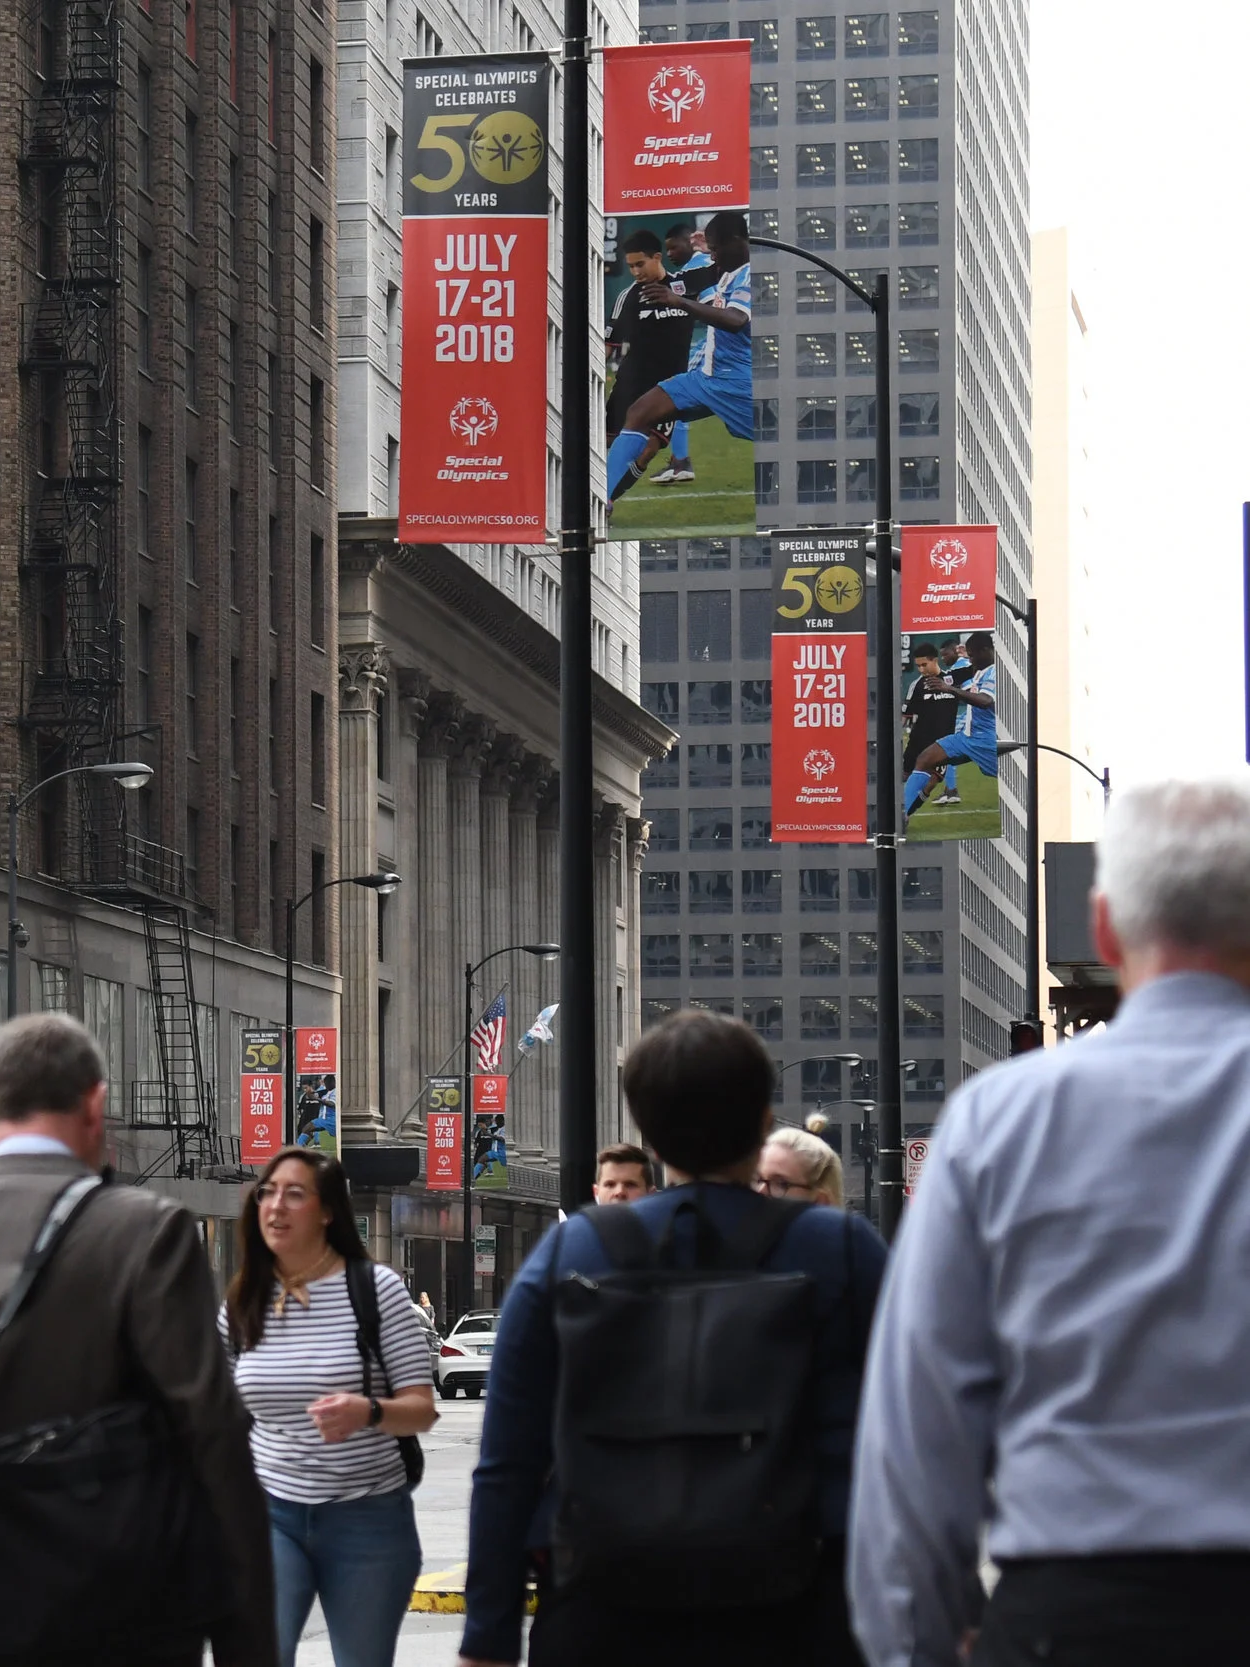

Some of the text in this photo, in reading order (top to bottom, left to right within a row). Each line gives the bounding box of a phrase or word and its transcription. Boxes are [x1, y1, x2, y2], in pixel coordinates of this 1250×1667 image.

[415, 70, 537, 90] SPECIAL OLYMPICS
[435, 90, 517, 107] CELEBRATES
[643, 132, 712, 149] Special
[409, 110, 544, 194] 50
[633, 150, 719, 168] Olympics
[621, 183, 733, 200] SPECIALOLYMPICS50.ORG
[454, 193, 498, 208] YEARS
[434, 233, 518, 272] JULY
[434, 279, 515, 317] 17-21
[435, 324, 514, 363] 2018
[445, 456, 503, 468] Special
[436, 469, 509, 483] Olympics
[405, 513, 539, 526] SPECIALOLYMPICS50.ORG
[779, 539, 859, 551] SPECIAL OLYMPICS
[792, 552, 846, 563] CELEBRATES
[776, 565, 864, 619] 50
[927, 581, 971, 592] Special
[920, 592, 975, 604] Olympics
[805, 618, 834, 629] YEARS
[793, 644, 847, 670] JULY
[793, 673, 846, 699] 17-21
[793, 702, 845, 728] 2018
[800, 786, 839, 795] Special
[795, 795, 843, 805] Olympics
[243, 1044, 281, 1067] 50
[250, 1078, 274, 1090] JULY
[250, 1091, 273, 1103] 17-21
[250, 1103, 273, 1115] 2018
[435, 1117, 455, 1127] JULY
[435, 1128, 454, 1137] 17-21
[435, 1138, 454, 1148] 2018
